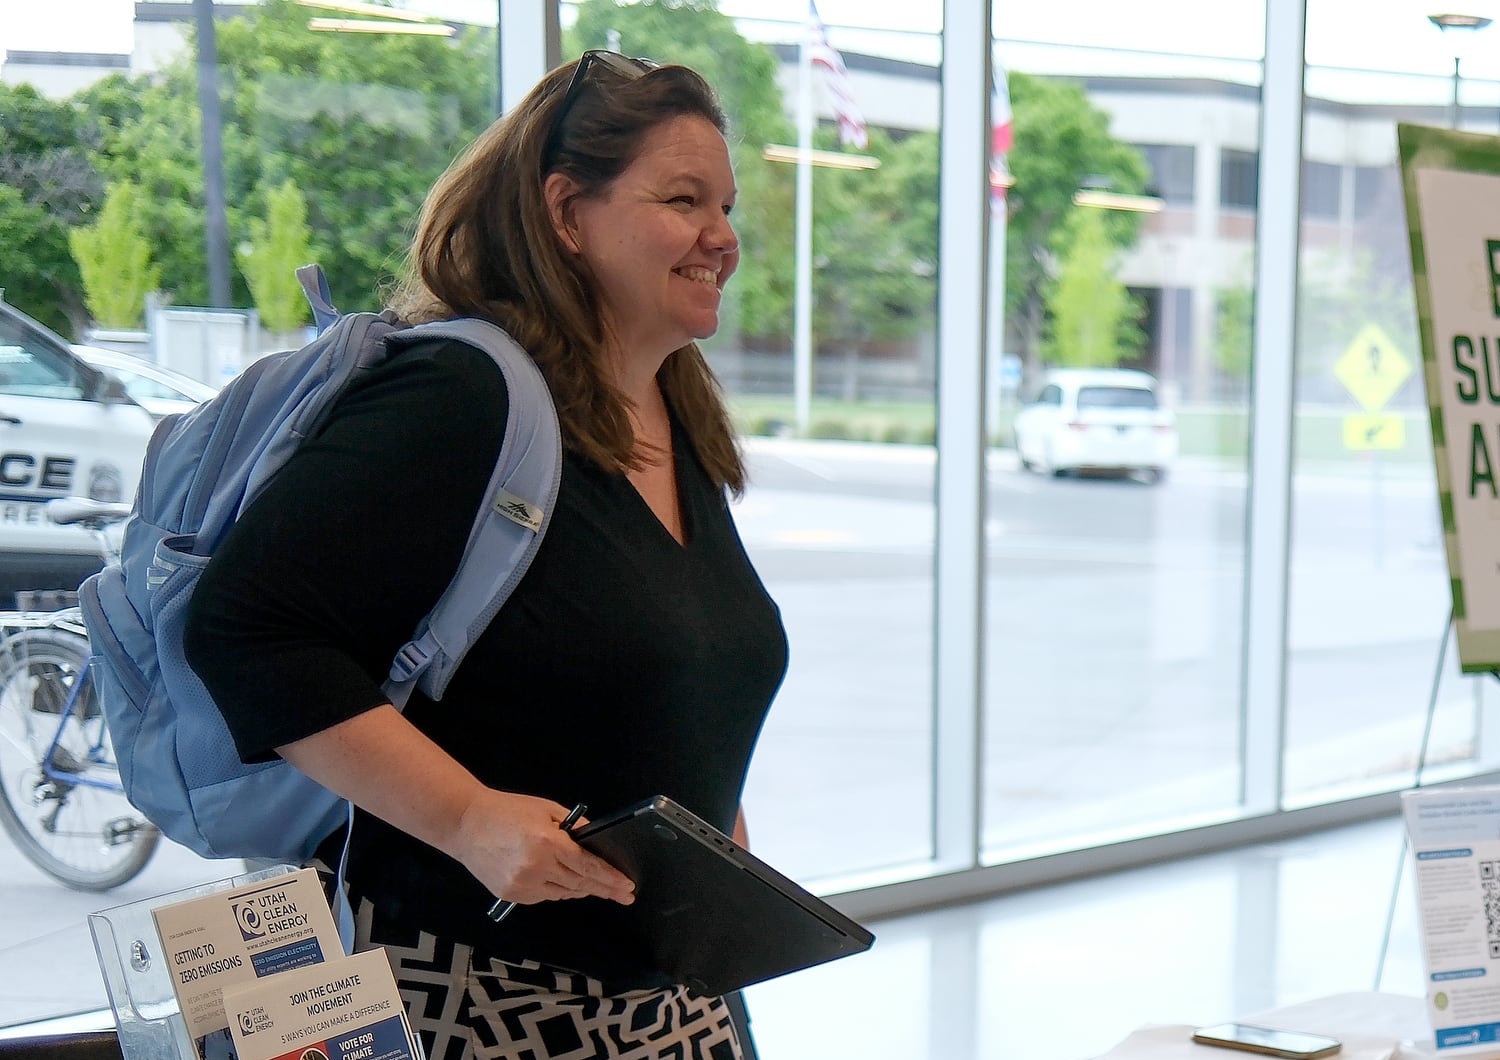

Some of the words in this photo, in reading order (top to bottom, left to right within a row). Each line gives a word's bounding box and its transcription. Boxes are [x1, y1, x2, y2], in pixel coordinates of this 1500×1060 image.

[258, 891, 287, 907] UTAH
[263, 903, 297, 920] CLEAN
[268, 913, 308, 934] ENERGY
[174, 946, 204, 965] GETTING
[203, 943, 215, 956] TO
[287, 943, 317, 955] ELECTRICITY
[180, 968, 198, 984] ZERO
[198, 955, 242, 978] EMISSIONS
[289, 994, 308, 1007] JOIN
[308, 987, 325, 1000] THE
[325, 975, 361, 995] CLIMATE
[251, 1007, 264, 1016] UTAH
[307, 993, 354, 1017] MOVEMENT
[253, 1014, 269, 1025] CLEAN
[255, 1021, 274, 1033] ENERGY
[281, 1035, 286, 1044] 5
[286, 1030, 304, 1043] WAYS
[303, 1026, 317, 1038] YOU
[316, 1021, 330, 1034] CAN
[329, 1015, 349, 1029] MAKE
[354, 1000, 391, 1020] DIFFERENCE
[338, 1036, 359, 1052] VOTE
[358, 1032, 375, 1046] FOR
